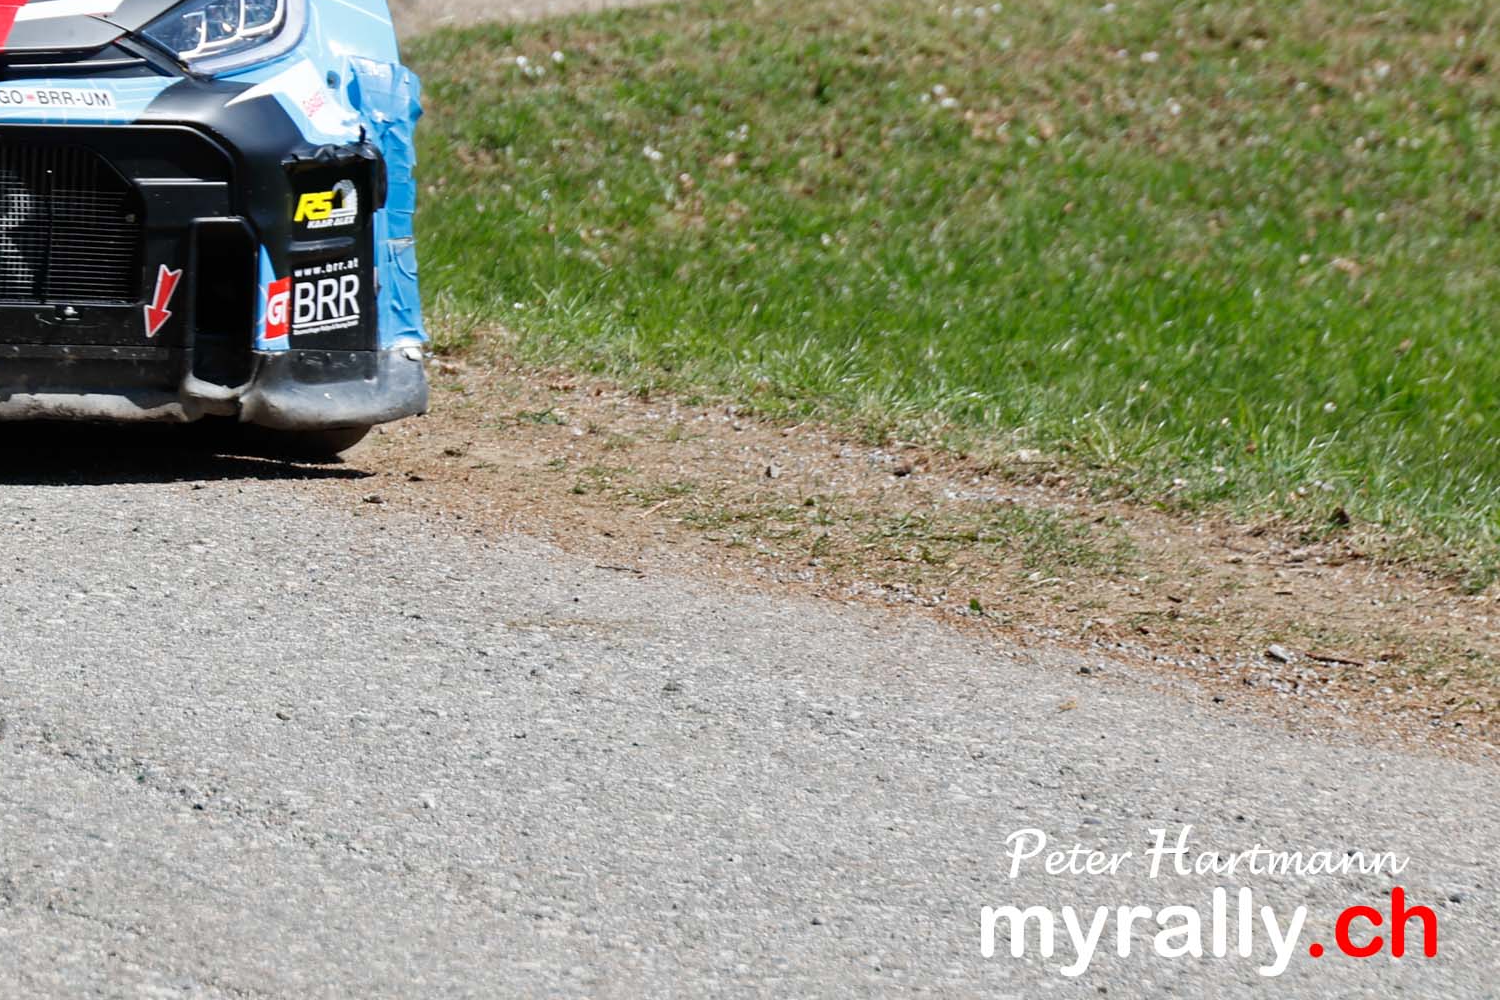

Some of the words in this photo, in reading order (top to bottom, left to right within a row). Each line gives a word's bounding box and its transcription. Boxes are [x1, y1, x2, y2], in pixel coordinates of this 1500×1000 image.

[36, 90, 110, 106] BRR-UM
[294, 191, 335, 222] RS
[295, 258, 358, 277] www.brr.at
[293, 274, 360, 324] BRR
